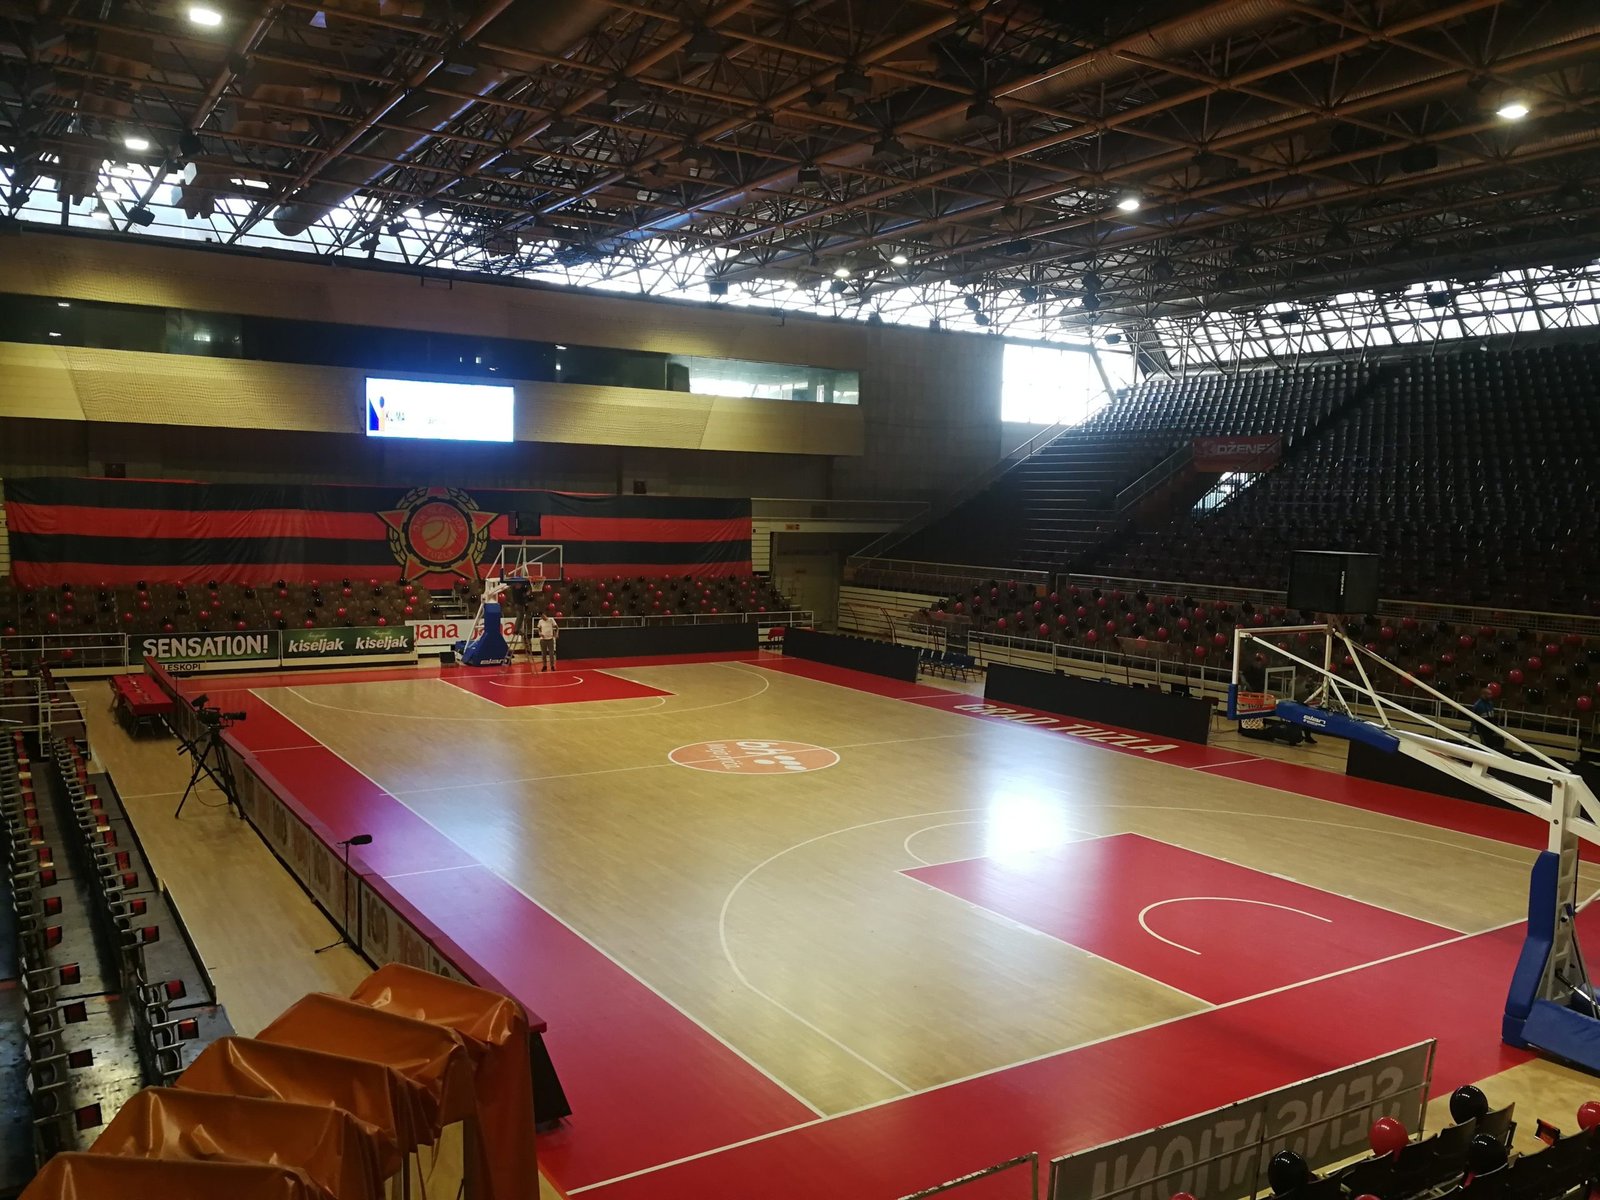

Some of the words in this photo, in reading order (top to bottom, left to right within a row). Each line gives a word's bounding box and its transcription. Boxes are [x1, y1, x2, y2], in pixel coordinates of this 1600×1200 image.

[142, 634, 268, 658] SENSATION!
[288, 638, 344, 653] kiseljak
[355, 635, 408, 651] kiseljak
[954, 703, 1060, 725] GRAD
[1050, 723, 1179, 754] TUZLA
